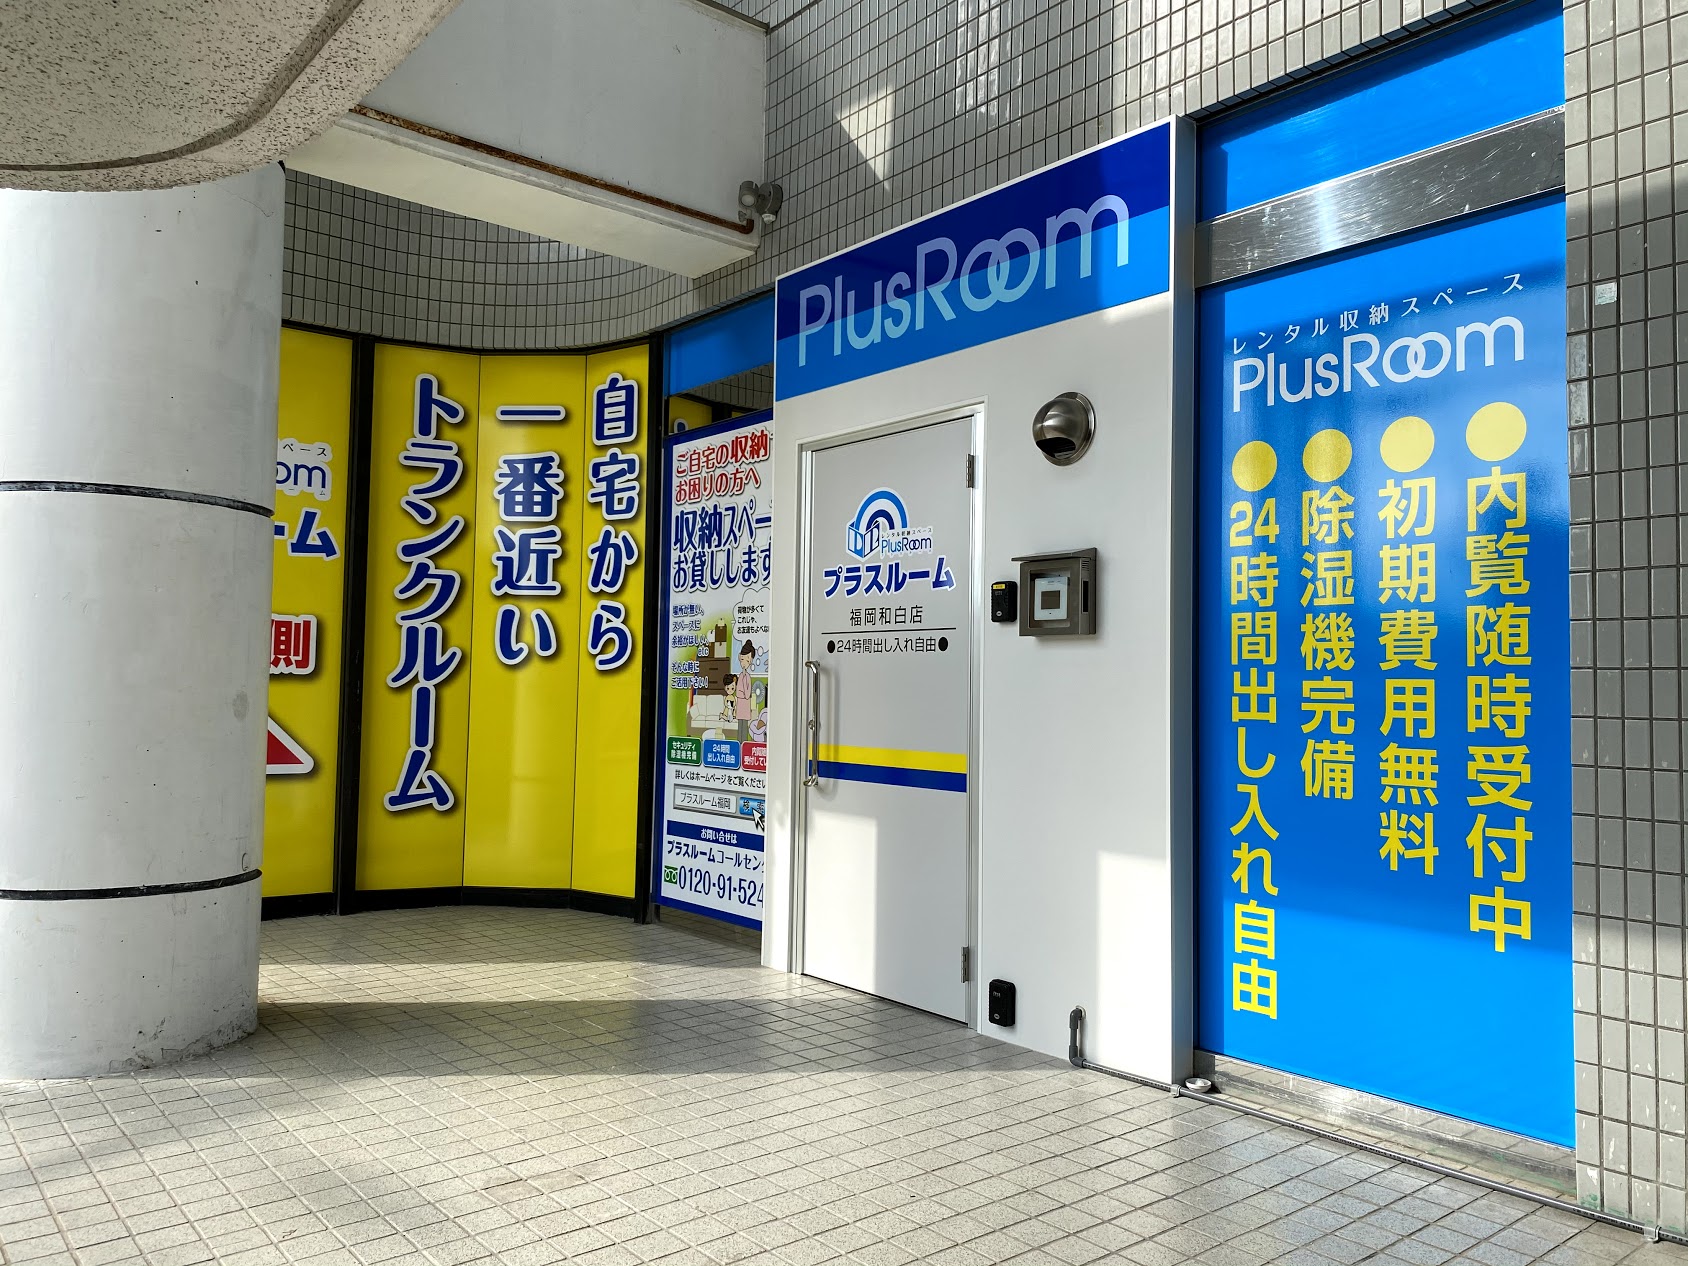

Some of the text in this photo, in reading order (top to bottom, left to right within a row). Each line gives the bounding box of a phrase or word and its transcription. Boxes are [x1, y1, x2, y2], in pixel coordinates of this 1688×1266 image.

[798, 194, 1130, 367] PlusRoom
[1233, 272, 1524, 354] レンタル収納スペース
[1233, 316, 1525, 413] PlusRoom
[588, 374, 640, 669] 自宅から
[675, 467, 760, 503] お困りの方へ
[274, 510, 338, 559] ム
[492, 406, 566, 664] 一番近い
[881, 537, 932, 554] PlusRoom
[385, 373, 464, 810] トランクルーム
[823, 557, 955, 598] プラスルーム
[849, 605, 924, 627] 福岡和白店
[1299, 485, 1356, 800] 除湿機完備
[1377, 476, 1439, 876] 初期費用無料
[712, 743, 731, 754] 24時間
[1465, 465, 1533, 953] 内覧随時受付中
[707, 752, 735, 764] 出し入れ自由
[1229, 497, 1280, 1020] 24時間出し入れ自由
[680, 792, 731, 810] プラスルーム福岡
[701, 828, 738, 844] お問い合せは
